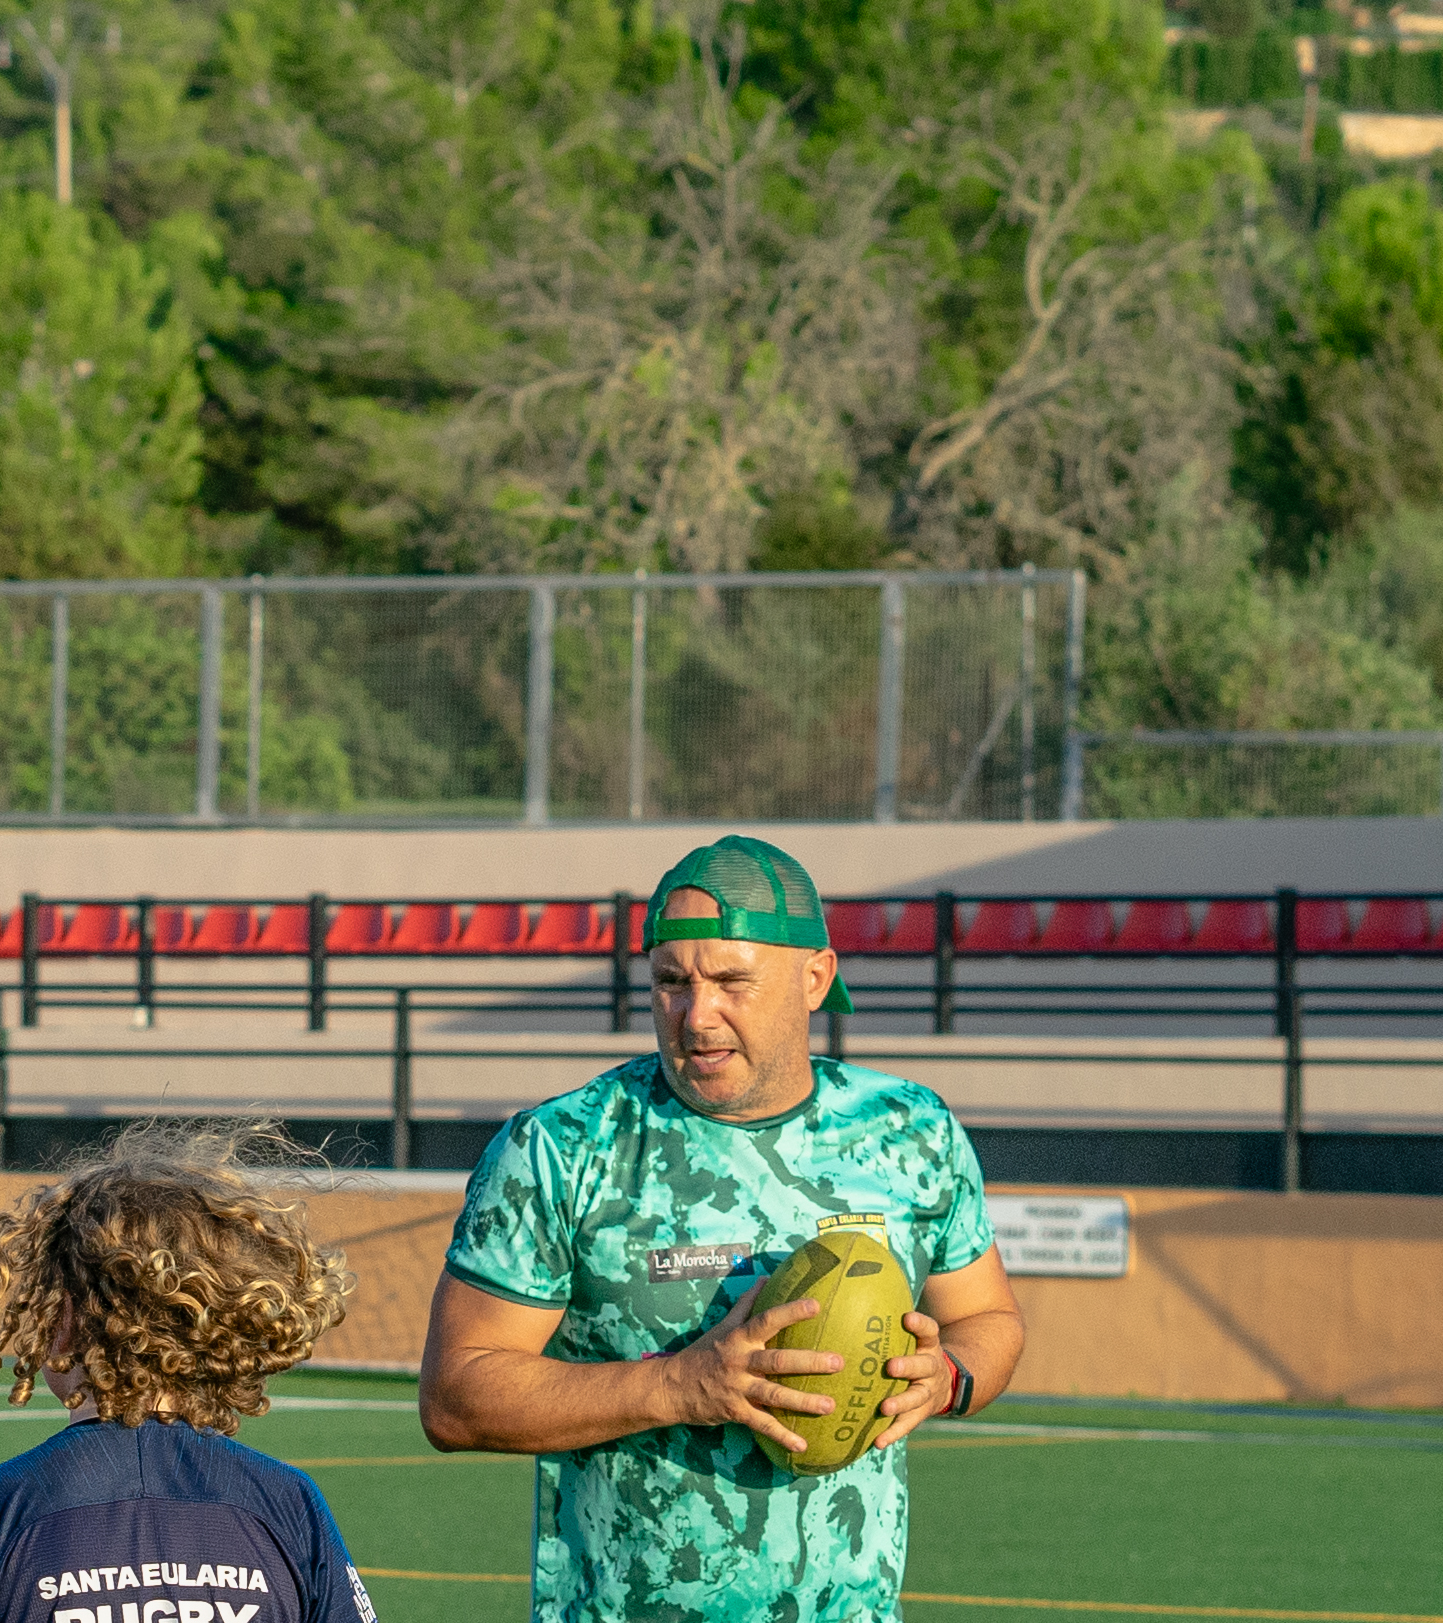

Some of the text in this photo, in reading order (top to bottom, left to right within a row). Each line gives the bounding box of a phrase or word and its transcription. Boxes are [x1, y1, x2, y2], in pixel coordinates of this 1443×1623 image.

[655, 1249, 729, 1269] La Morocha
[834, 1315, 884, 1442] OFFLOAD
[38, 1562, 269, 1600] SANTA EULARIA
